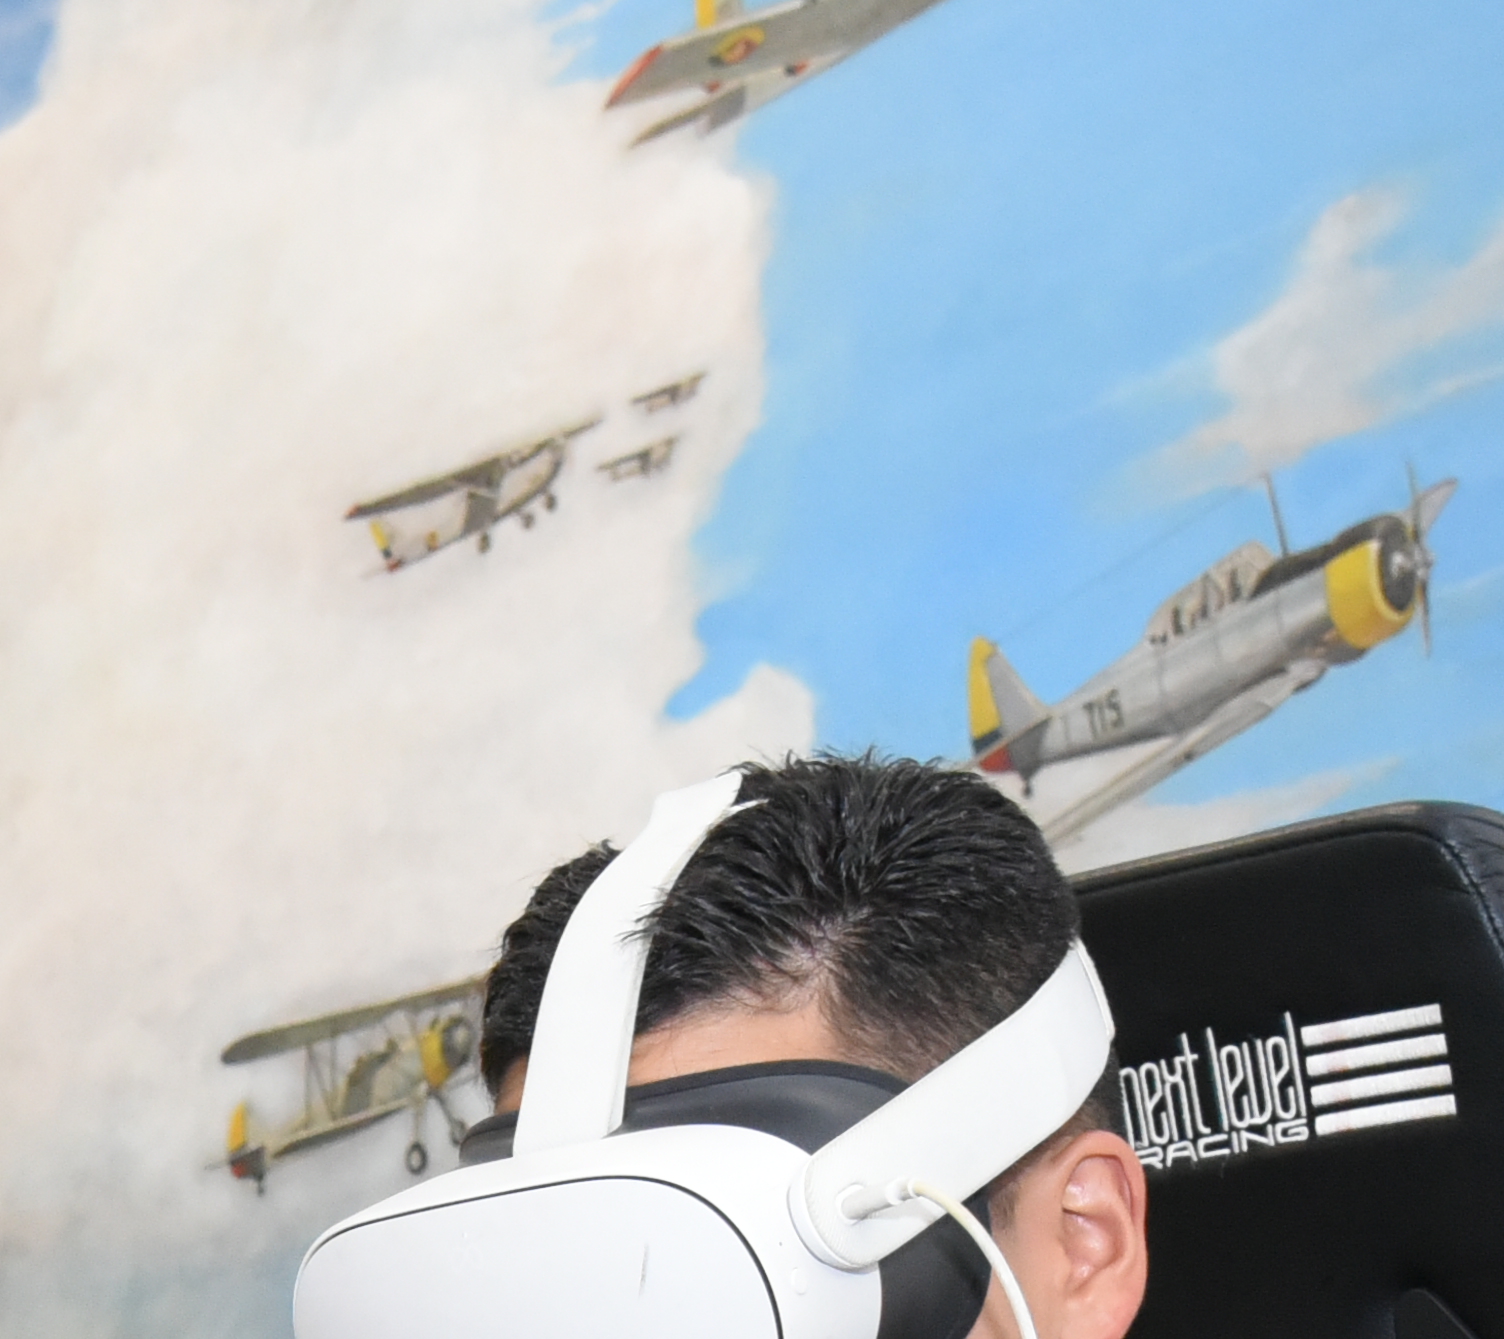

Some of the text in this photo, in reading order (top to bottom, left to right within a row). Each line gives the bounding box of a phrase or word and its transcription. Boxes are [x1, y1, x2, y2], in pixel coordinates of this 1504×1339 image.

[1118, 1010, 1308, 1150] next level
[1134, 1117, 1310, 1171] RACING
